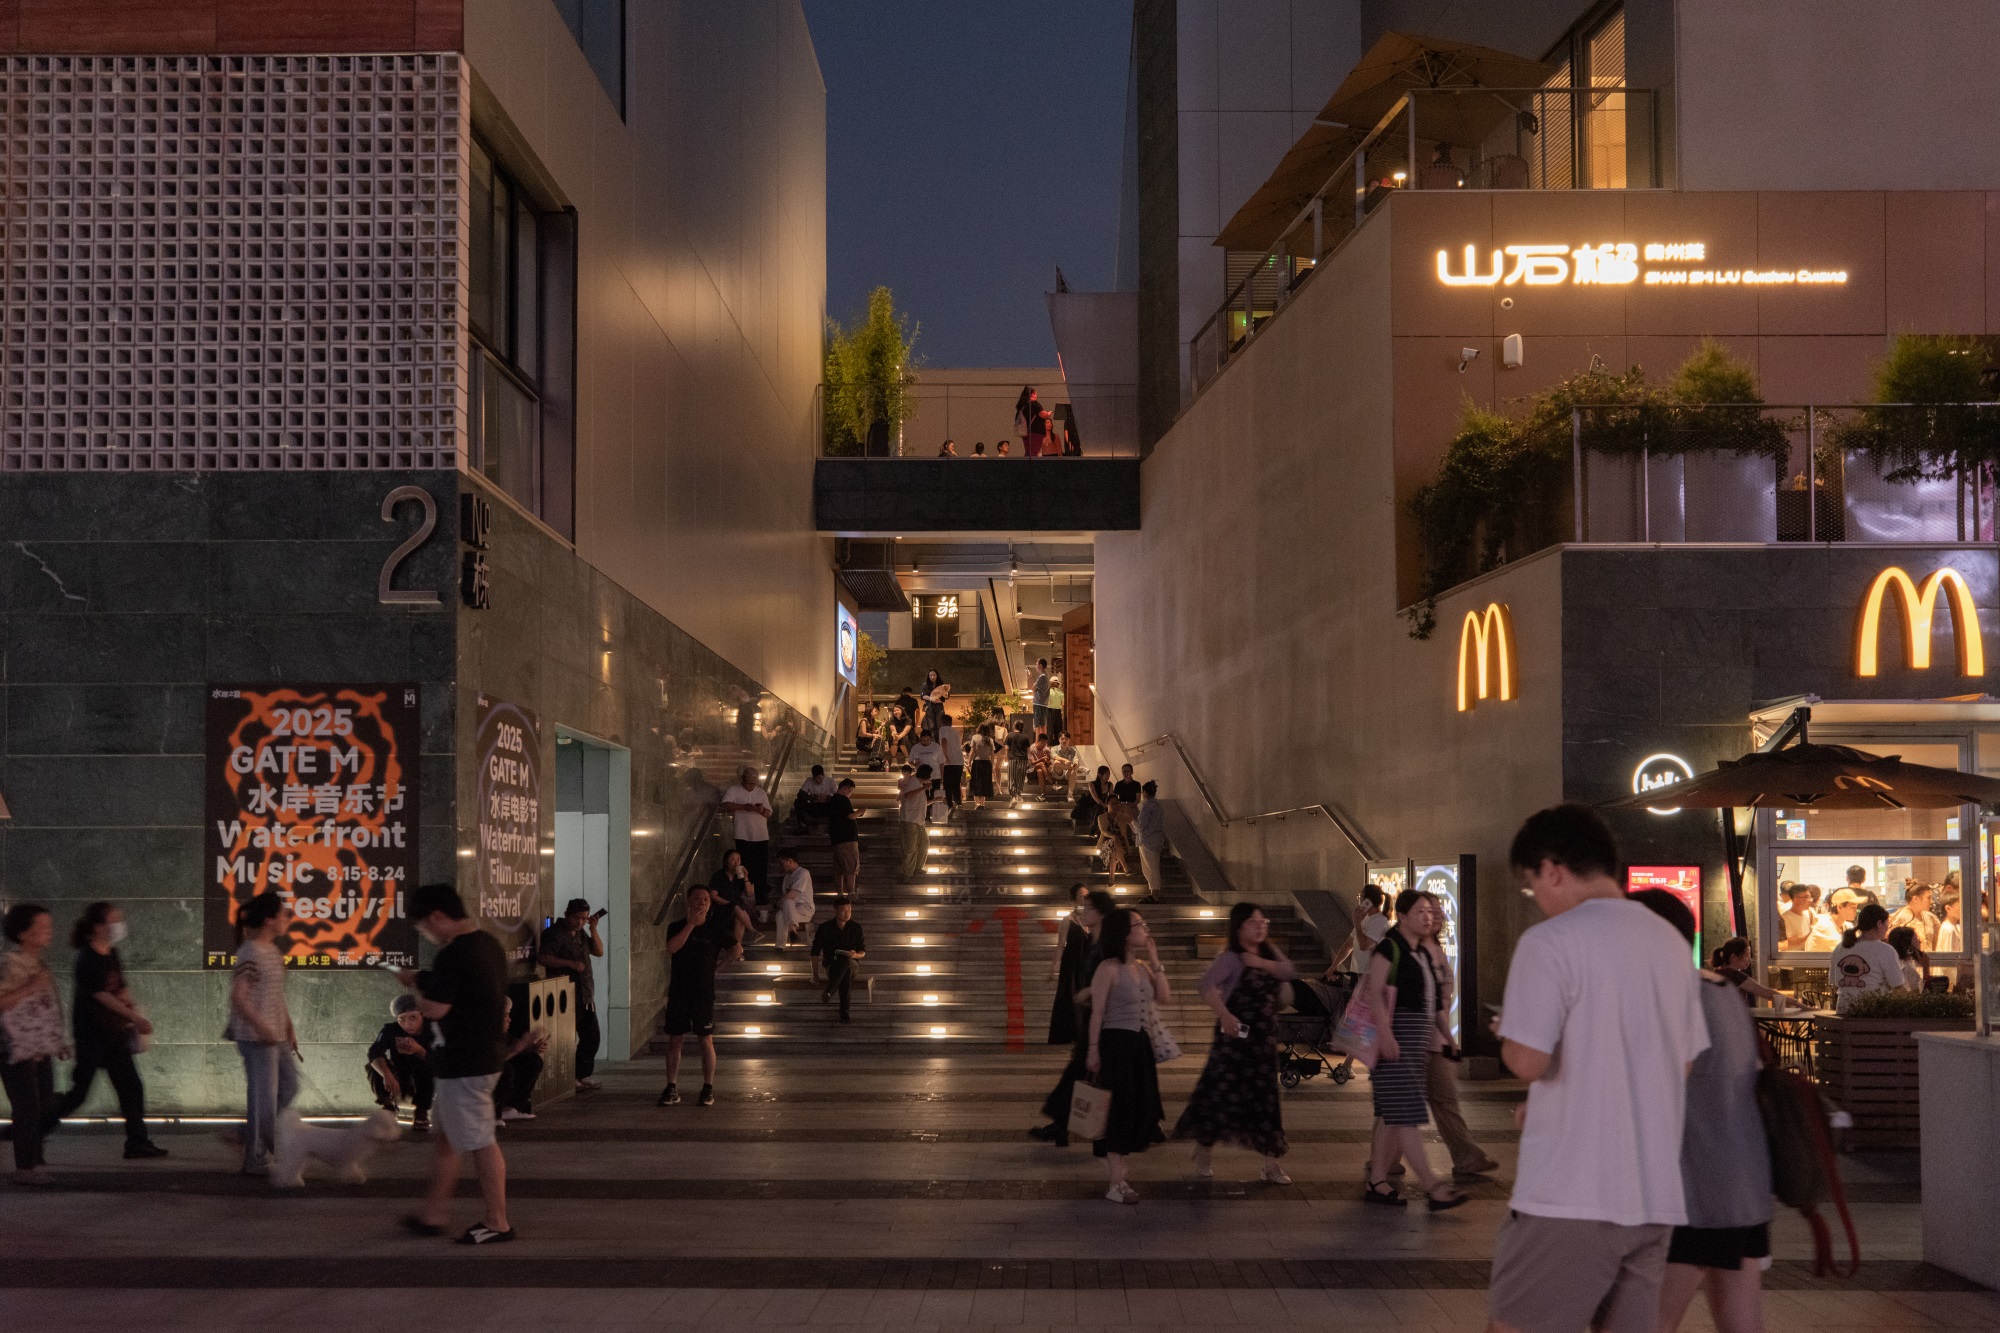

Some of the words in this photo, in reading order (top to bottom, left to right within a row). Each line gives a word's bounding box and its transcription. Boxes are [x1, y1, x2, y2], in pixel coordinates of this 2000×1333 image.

[1645, 271, 1686, 284] SHAN
[1689, 271, 1714, 284] SHI
[1716, 271, 1740, 283] LIU
[379, 485, 441, 604] 2
[271, 708, 353, 736] 2025
[497, 722, 523, 754] 2025
[231, 745, 318, 774] GATE
[330, 746, 359, 773] M
[489, 754, 517, 786] GATE
[520, 763, 529, 788] M
[248, 783, 406, 814] 水岸音乐节
[490, 791, 538, 824] 水岸电影节
[217, 820, 406, 849] Waterfront
[480, 823, 537, 856] Waterfront
[216, 855, 315, 884] Music
[327, 866, 405, 881] 8.15-8.24
[489, 857, 512, 885] Film
[513, 871, 537, 886] 8.15-8.24
[1427, 879, 1447, 895] 2025
[479, 890, 521, 918] Festival
[1443, 899, 1452, 915] M
